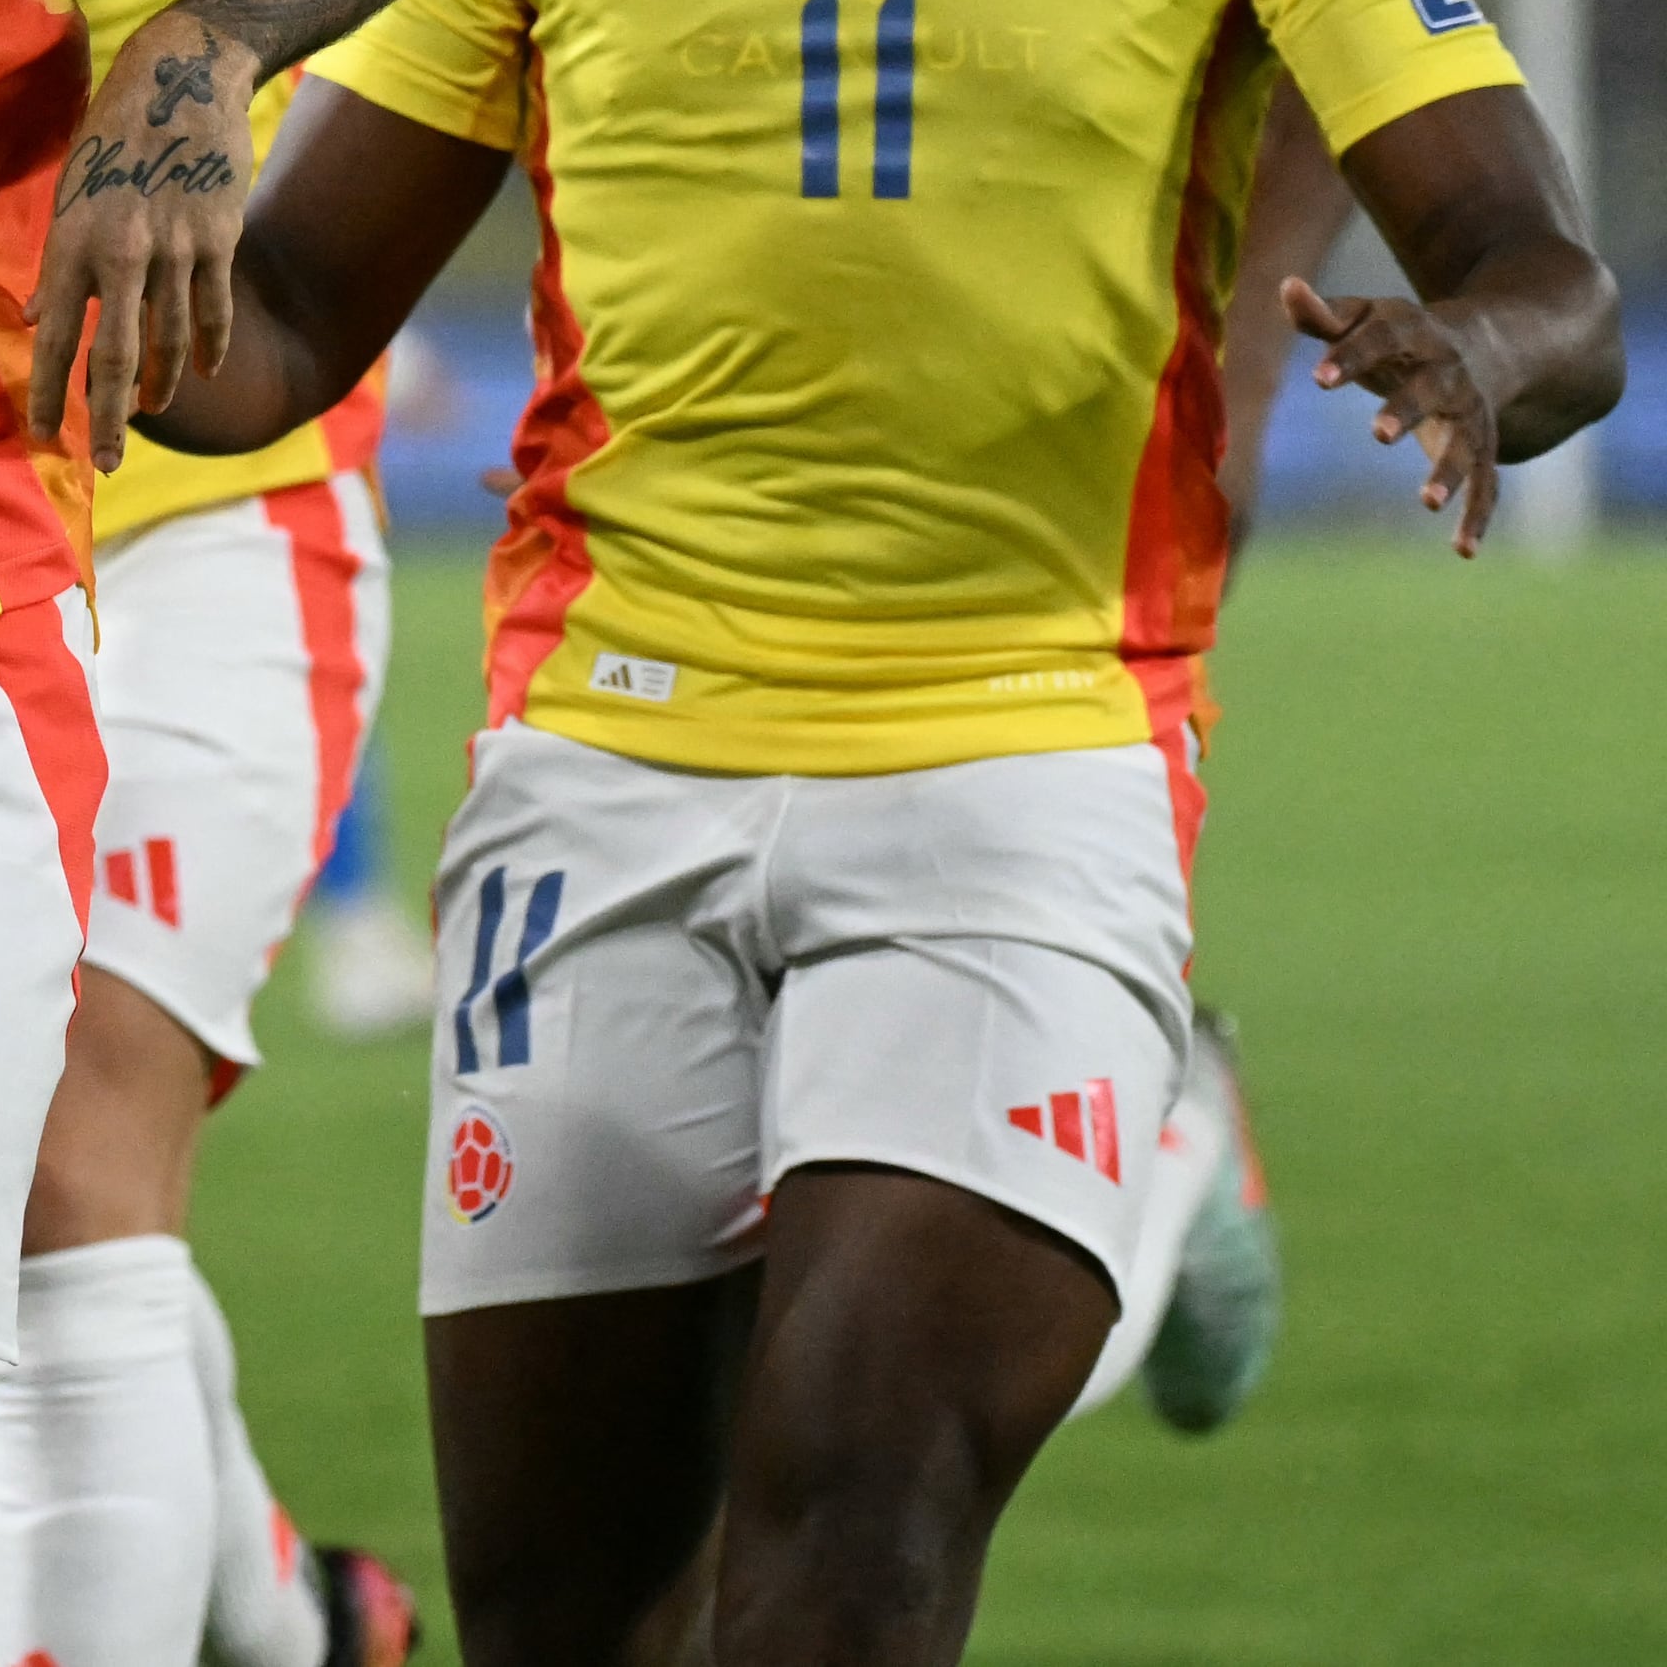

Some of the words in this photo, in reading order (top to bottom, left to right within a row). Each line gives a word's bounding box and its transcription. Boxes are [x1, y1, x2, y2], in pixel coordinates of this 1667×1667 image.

[679, 24, 1049, 78] CAULT
[55, 135, 237, 218] Charlotte
[454, 865, 566, 1075] 11
